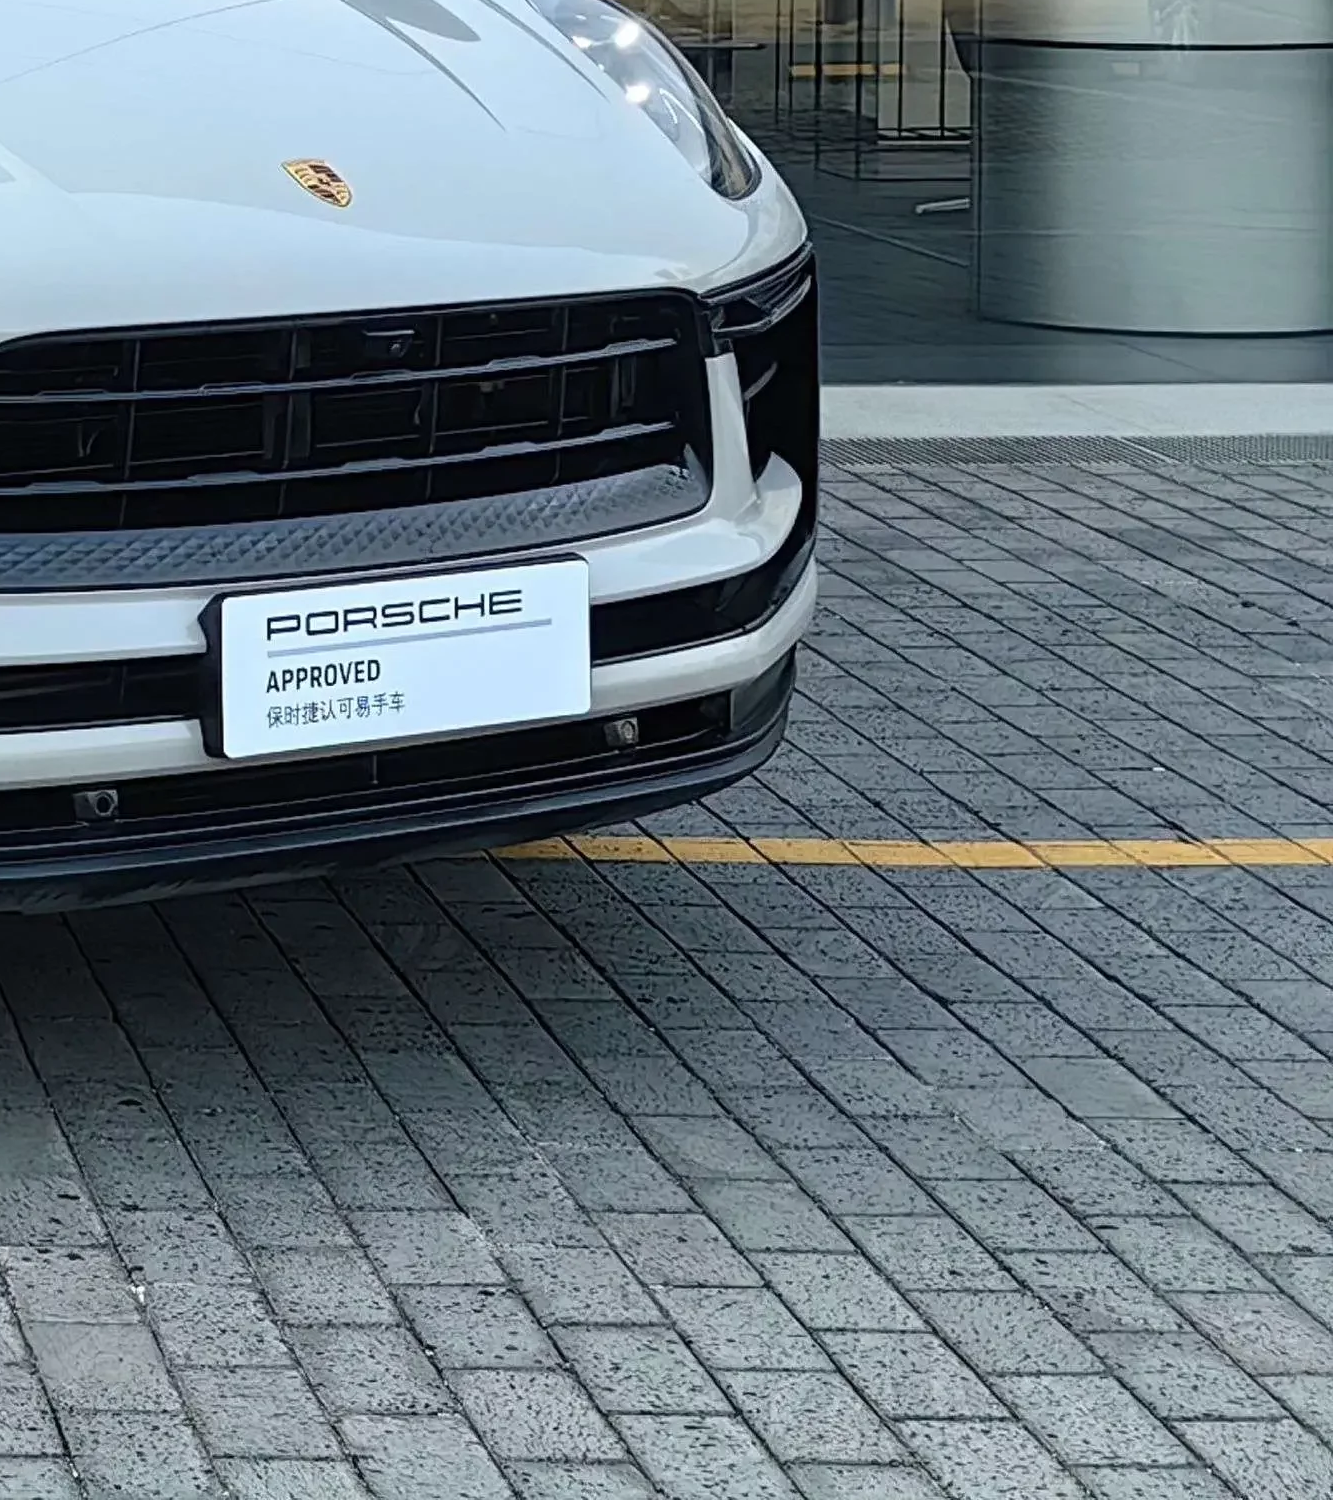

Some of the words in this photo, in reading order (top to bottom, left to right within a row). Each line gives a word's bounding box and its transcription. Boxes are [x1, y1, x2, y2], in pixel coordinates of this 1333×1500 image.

[266, 589, 523, 641] PORSCHE
[266, 659, 381, 693] APPROVED
[266, 691, 406, 728] 保时捷认可易手车
